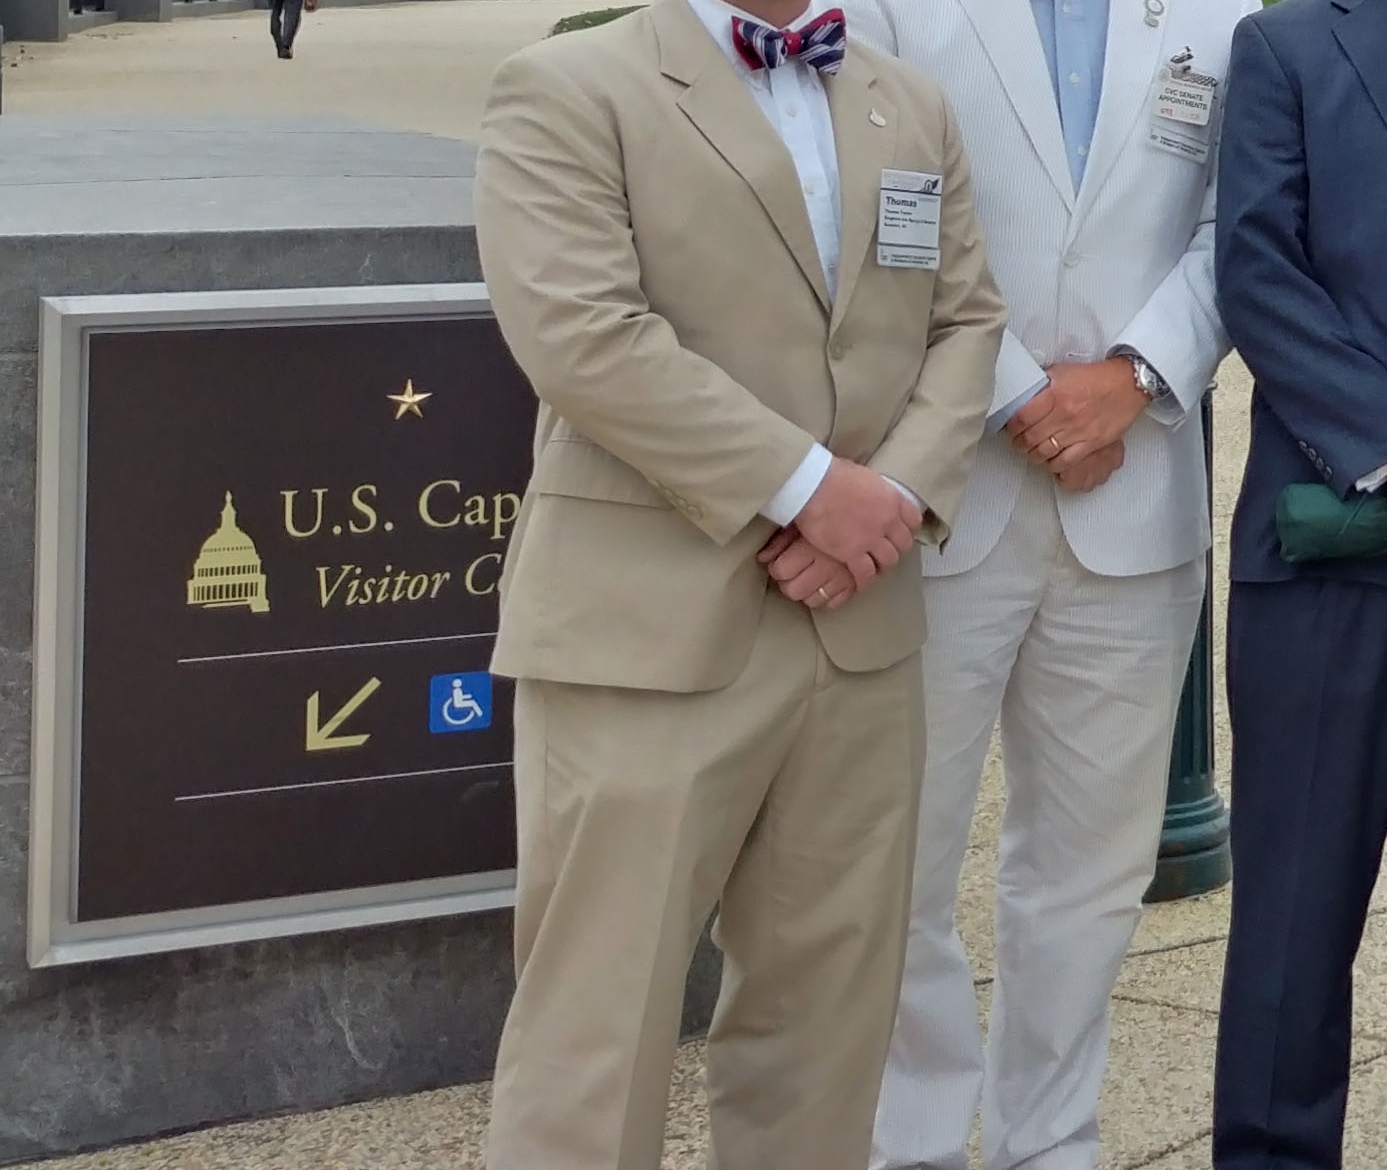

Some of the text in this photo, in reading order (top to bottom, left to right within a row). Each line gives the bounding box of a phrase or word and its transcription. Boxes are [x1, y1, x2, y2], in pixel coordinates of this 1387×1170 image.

[1158, 94, 1208, 110] APPOINTMENTS
[885, 196, 917, 208] Thomas
[279, 483, 395, 538] U.S.
[314, 552, 503, 610] Visitor C
